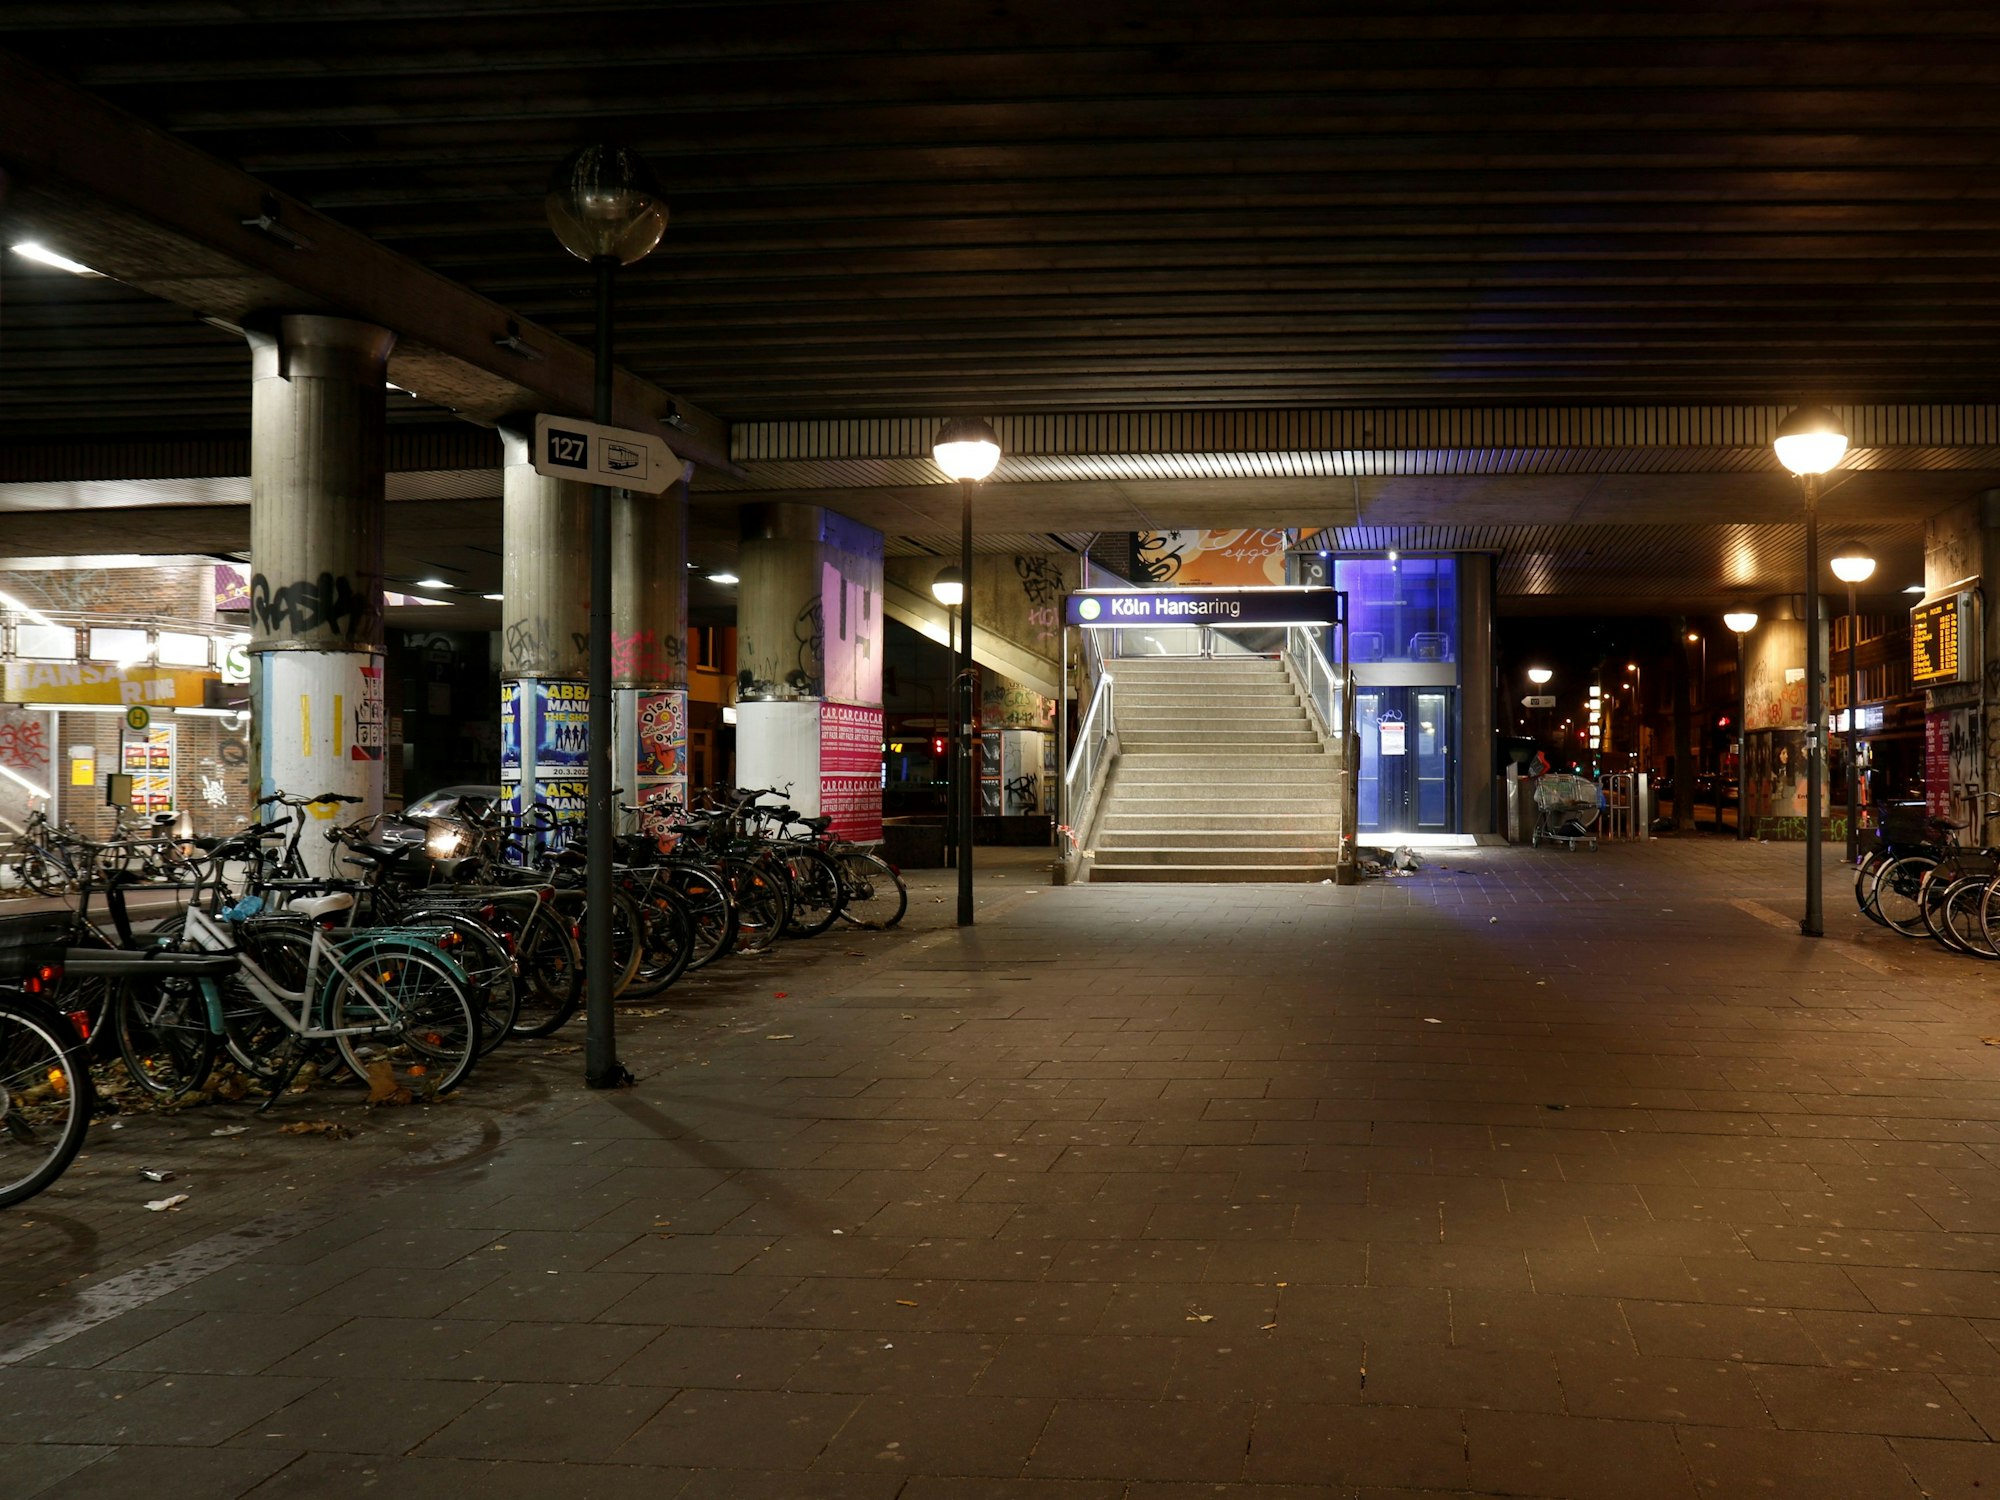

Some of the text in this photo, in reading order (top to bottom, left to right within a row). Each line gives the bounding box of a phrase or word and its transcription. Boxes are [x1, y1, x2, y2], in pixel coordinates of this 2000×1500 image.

[551, 437, 585, 462] 127
[1111, 598, 1150, 616] Köln
[1156, 598, 1241, 618] Hansaring
[4, 663, 129, 691] HANSA
[119, 678, 176, 705] RING
[544, 712, 588, 722] THE SHO
